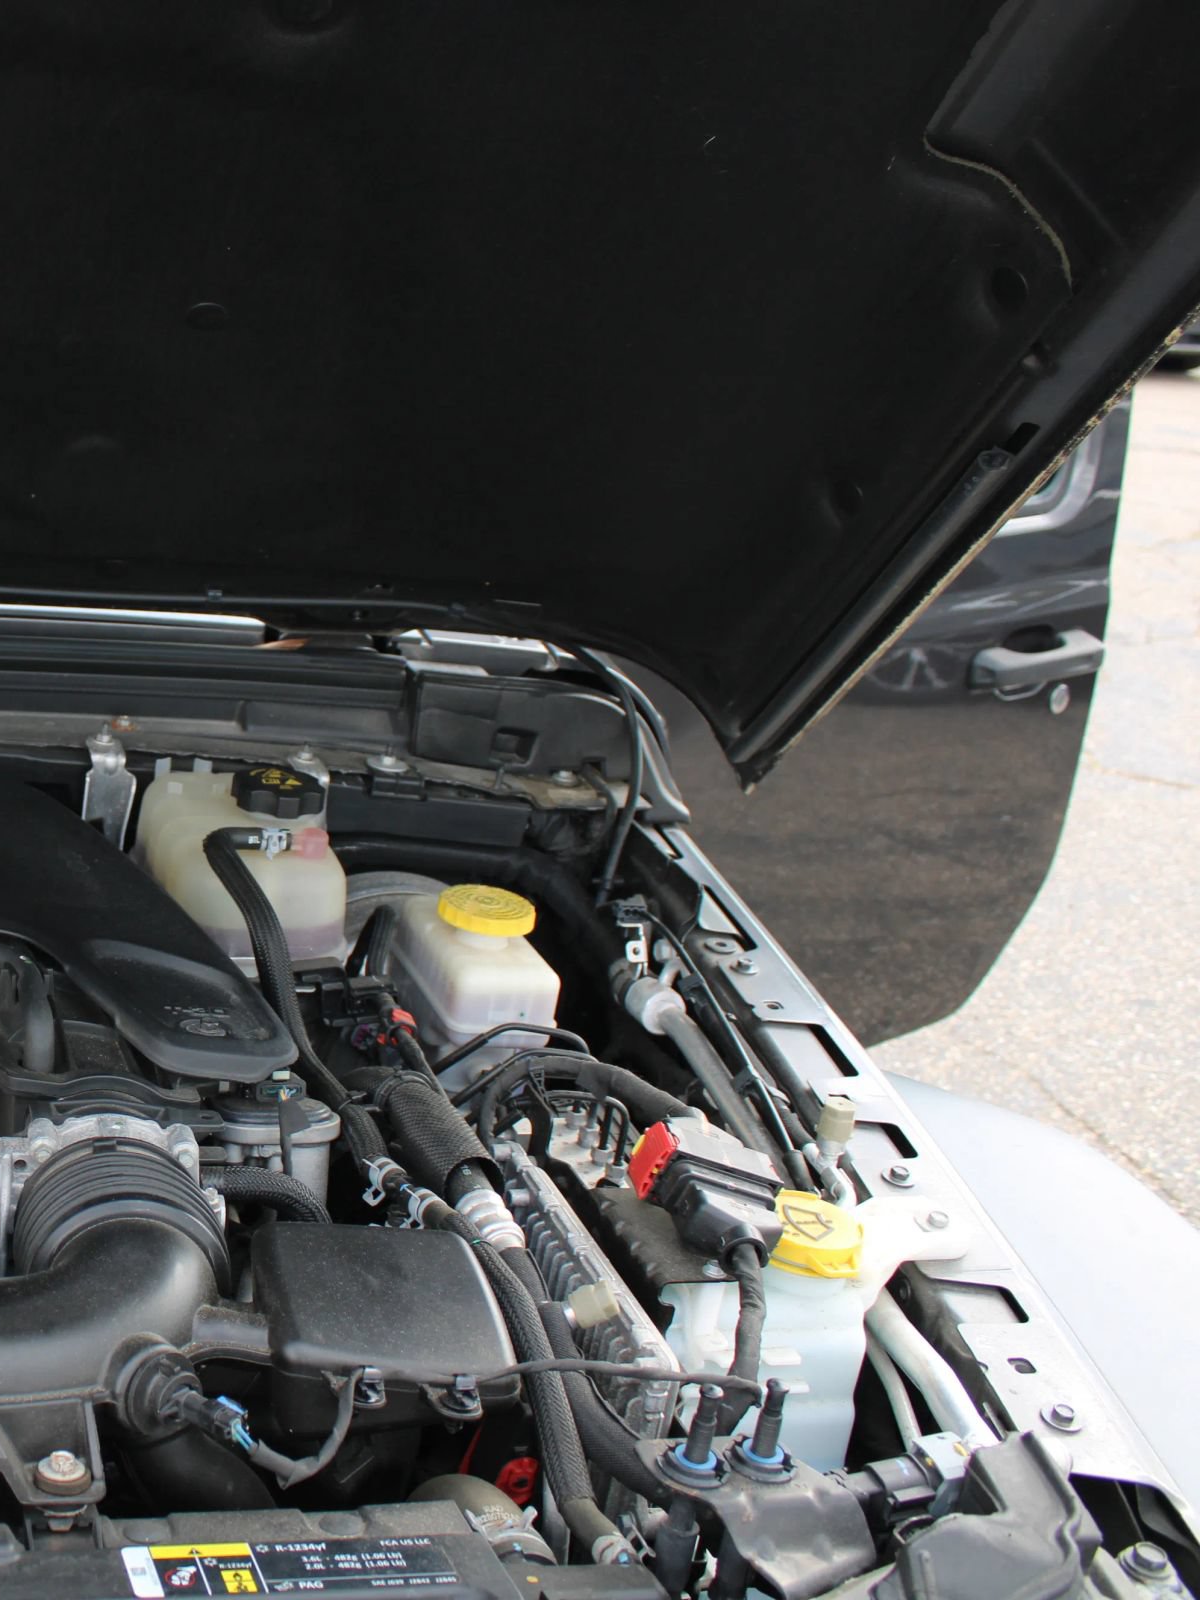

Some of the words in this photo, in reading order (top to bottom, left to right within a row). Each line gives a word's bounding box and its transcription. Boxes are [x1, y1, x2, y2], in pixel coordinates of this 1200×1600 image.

[380, 1538, 399, 1547] FCA
[400, 1538, 414, 1546] US
[414, 1537, 431, 1546] LLC
[273, 1542, 327, 1553] R-1234yf
[298, 1581, 324, 1590] PAG
